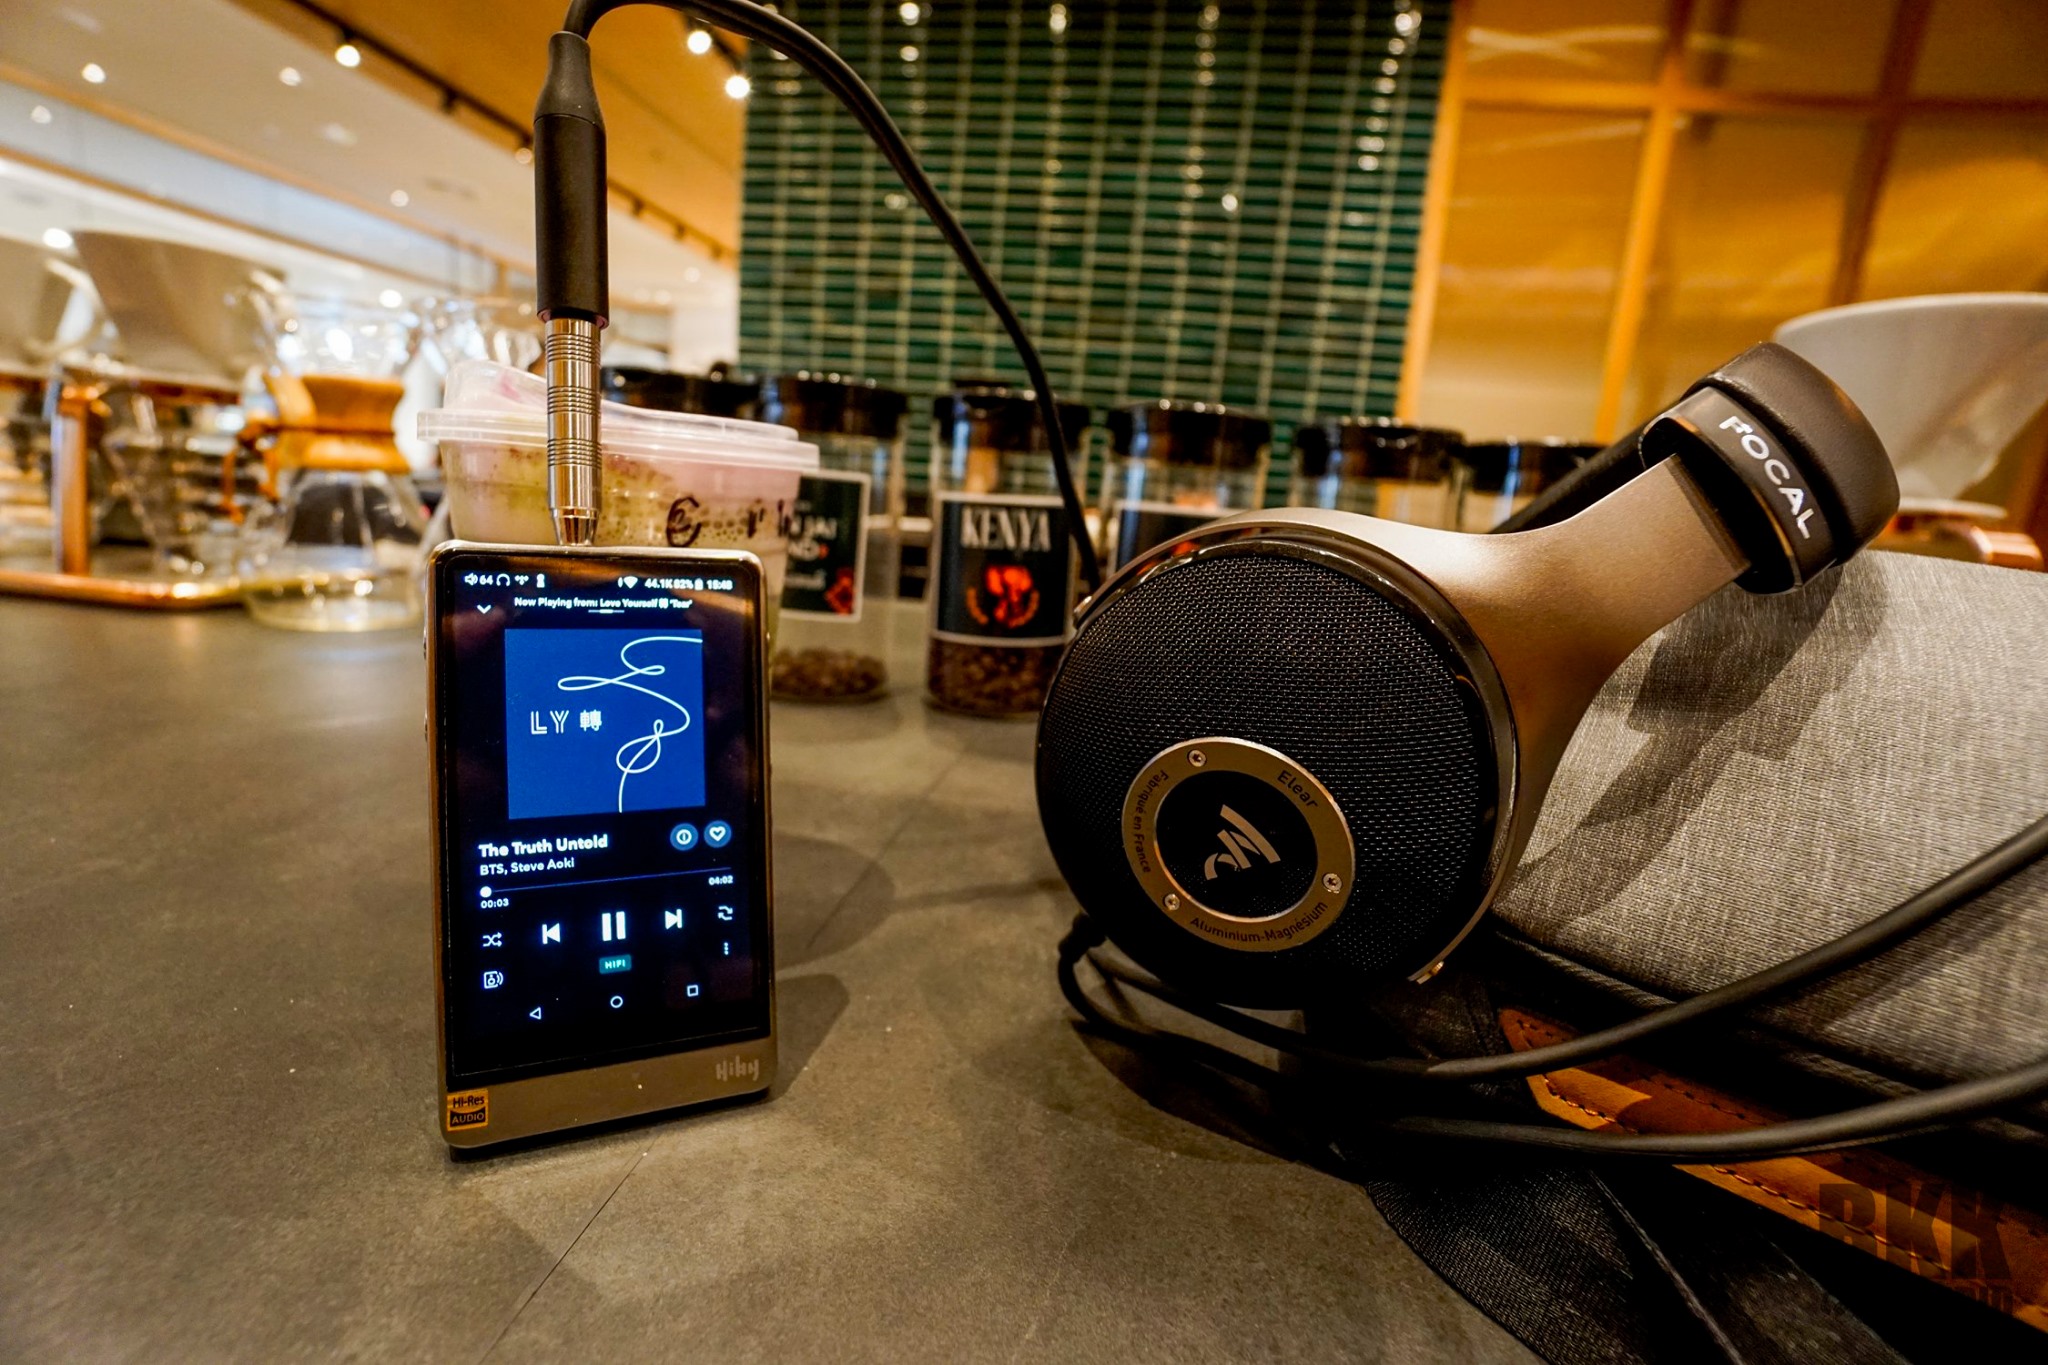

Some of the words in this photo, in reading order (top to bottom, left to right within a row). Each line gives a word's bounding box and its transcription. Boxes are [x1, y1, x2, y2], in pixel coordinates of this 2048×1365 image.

[1719, 416, 1814, 539] FOCAL
[961, 506, 1051, 552] KENYA
[480, 575, 494, 586] 64
[514, 597, 537, 607] Now
[538, 597, 573, 610] Playing
[600, 598, 621, 608] Love
[621, 598, 659, 609] Yourself
[530, 710, 569, 735] LY
[1134, 769, 1169, 814] Fabriqué
[1277, 769, 1319, 809] Elear
[1133, 815, 1143, 830] en
[478, 842, 509, 858] The
[511, 838, 553, 856] Truth
[556, 833, 608, 852] Untold
[1133, 833, 1152, 874] France
[479, 863, 508, 876] BTS,
[510, 860, 545, 874] Steve
[546, 856, 575, 871] Aoki
[708, 875, 734, 886] 04:02
[480, 898, 509, 909] 00:03
[1190, 901, 1328, 943] Aluminium-Magnésium
[451, 1110, 486, 1125] AUDIO
